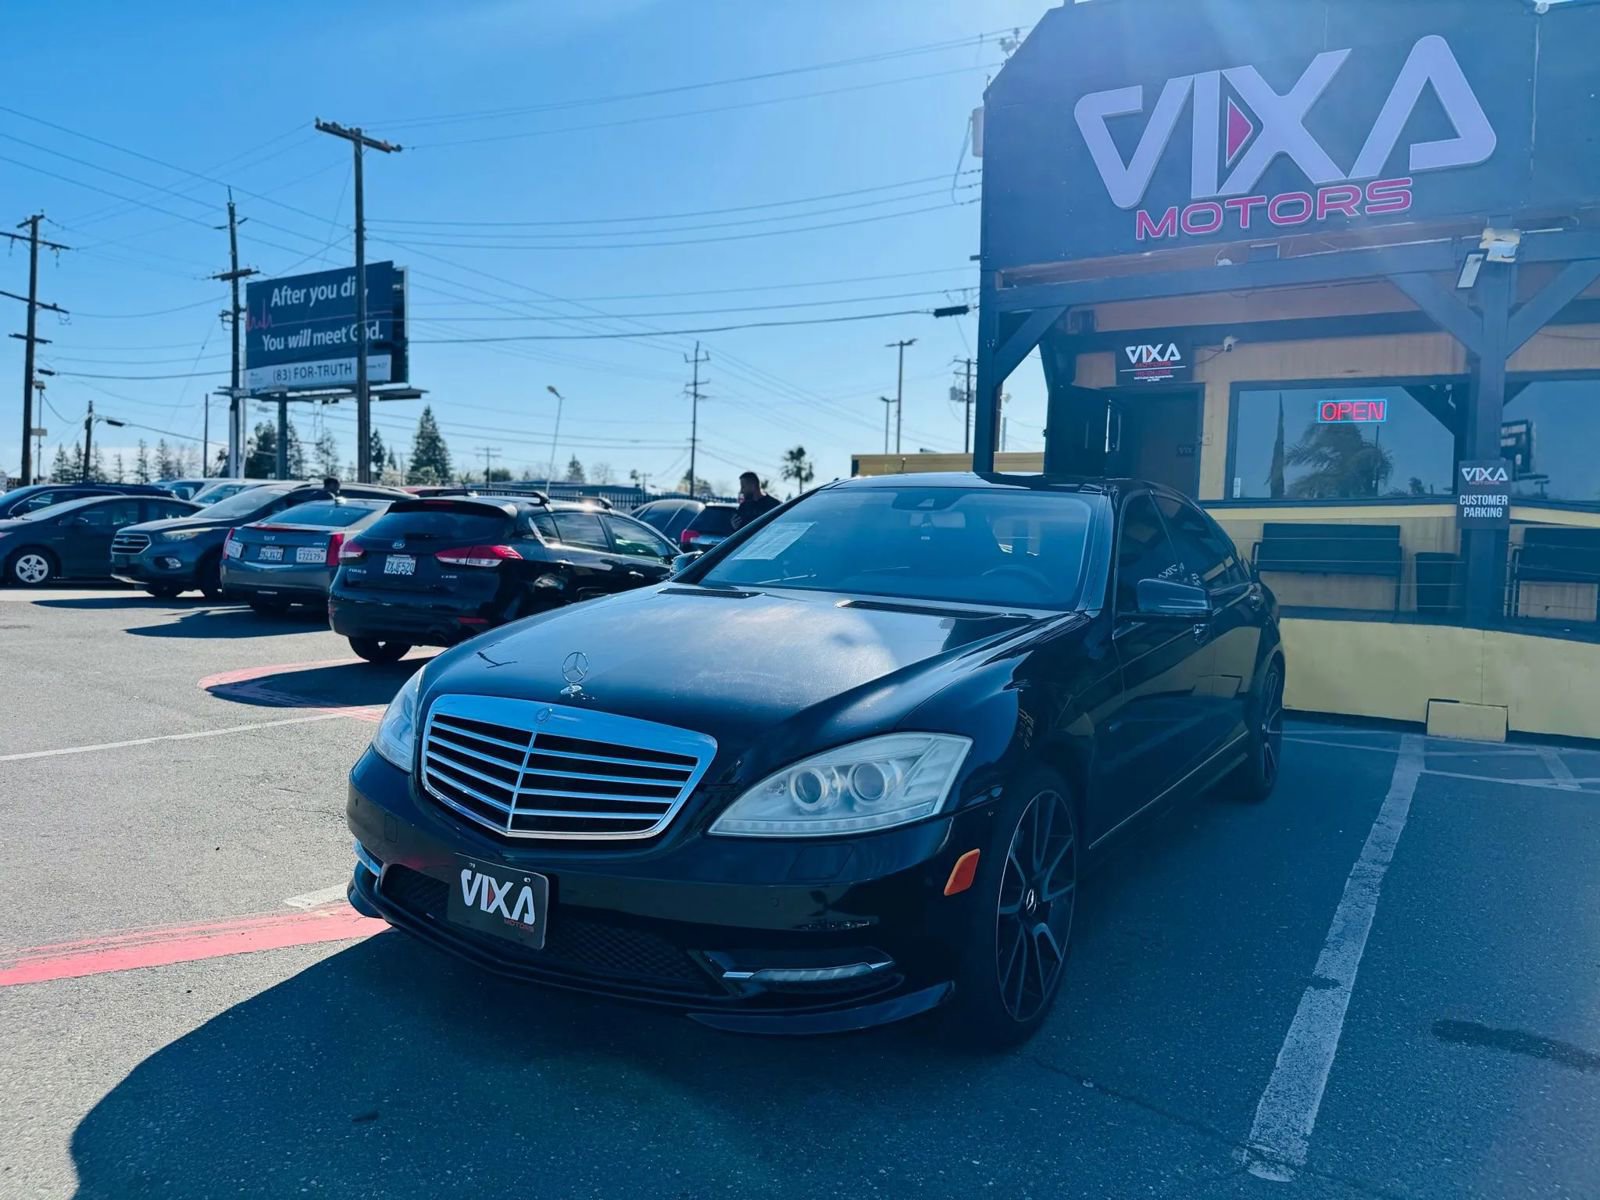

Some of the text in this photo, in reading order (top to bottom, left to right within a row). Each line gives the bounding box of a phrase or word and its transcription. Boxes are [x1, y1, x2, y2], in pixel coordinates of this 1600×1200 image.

[1073, 34, 1497, 209] VIXA
[1135, 176, 1414, 241] MOTORS
[271, 275, 369, 308] After you di,
[262, 334, 284, 352] You
[287, 328, 312, 349] will
[313, 326, 347, 347] meet
[1125, 342, 1181, 364] VIXA
[272, 369, 291, 384] (83)
[293, 362, 352, 381] FOR-TRUTH
[1321, 401, 1384, 421] OPEN
[1461, 466, 1508, 481] VIXA
[1459, 494, 1508, 506] CUSTOMER
[1463, 507, 1503, 518] PARKING
[460, 868, 536, 926] VIXA
